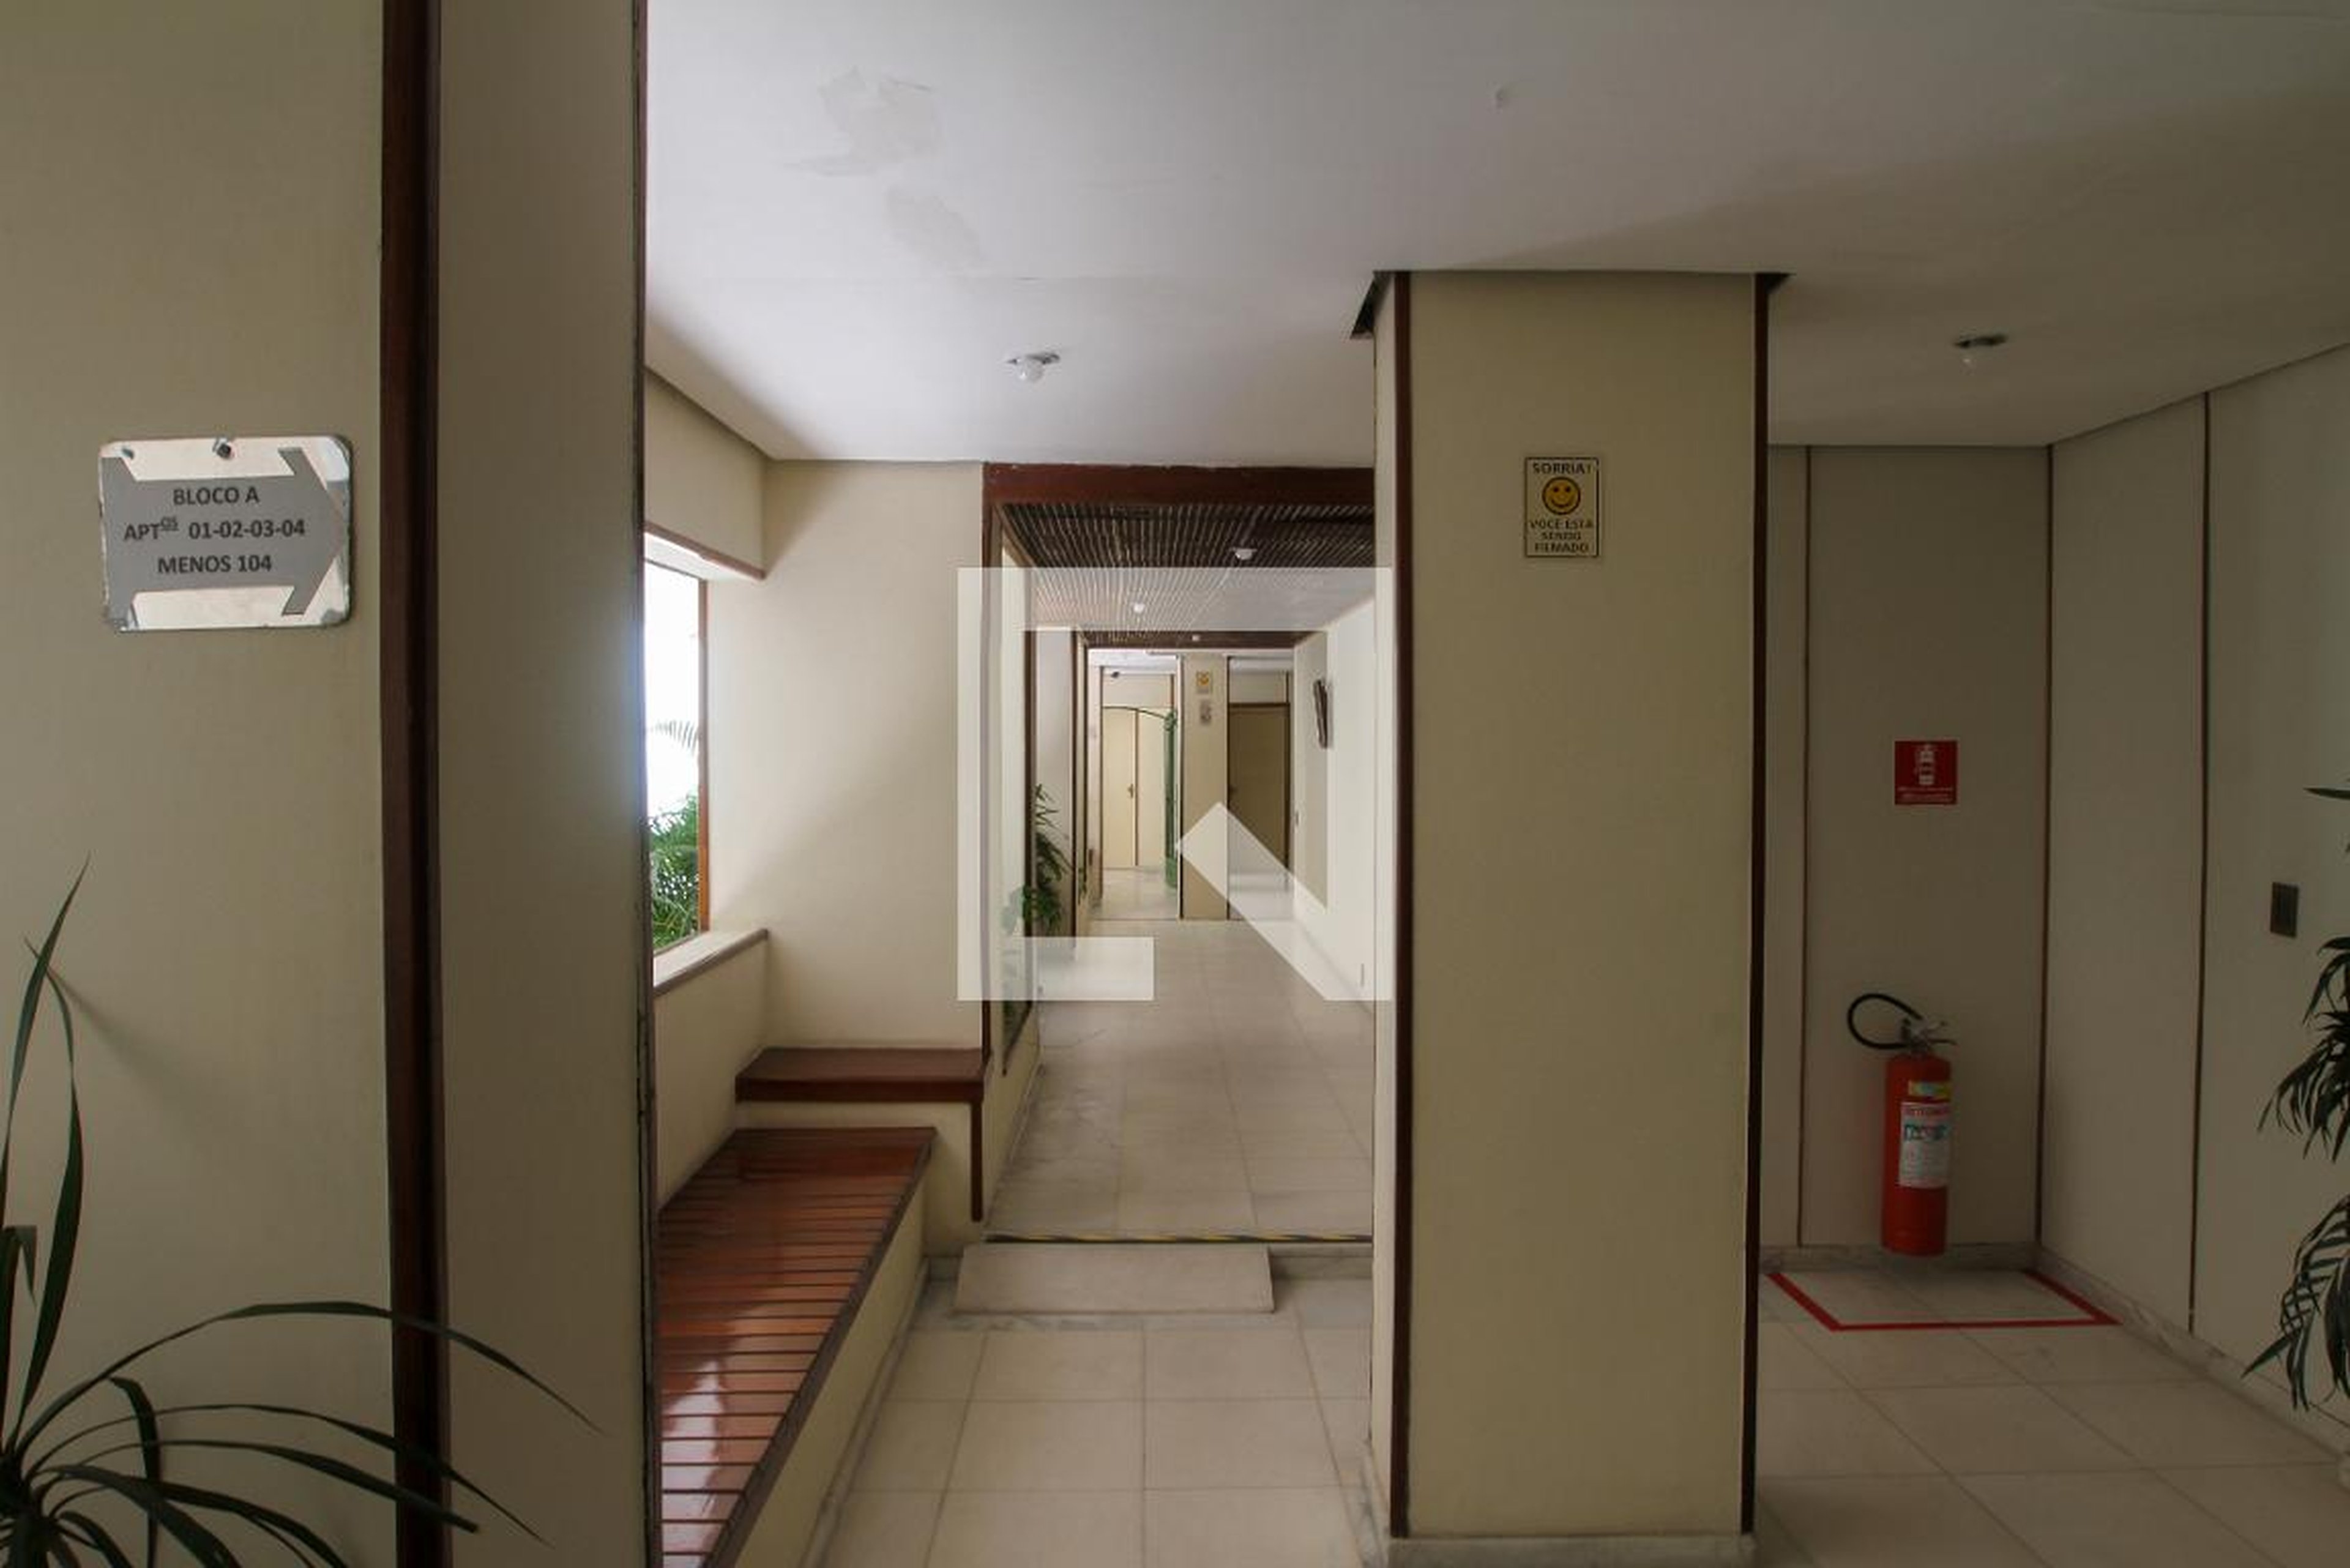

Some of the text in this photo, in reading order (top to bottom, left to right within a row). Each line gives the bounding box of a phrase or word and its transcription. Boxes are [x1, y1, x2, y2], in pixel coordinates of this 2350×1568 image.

[173, 487, 260, 506] BLOCO A
[188, 520, 305, 539] 01-02-03-04
[158, 554, 272, 574] MENOS 104
